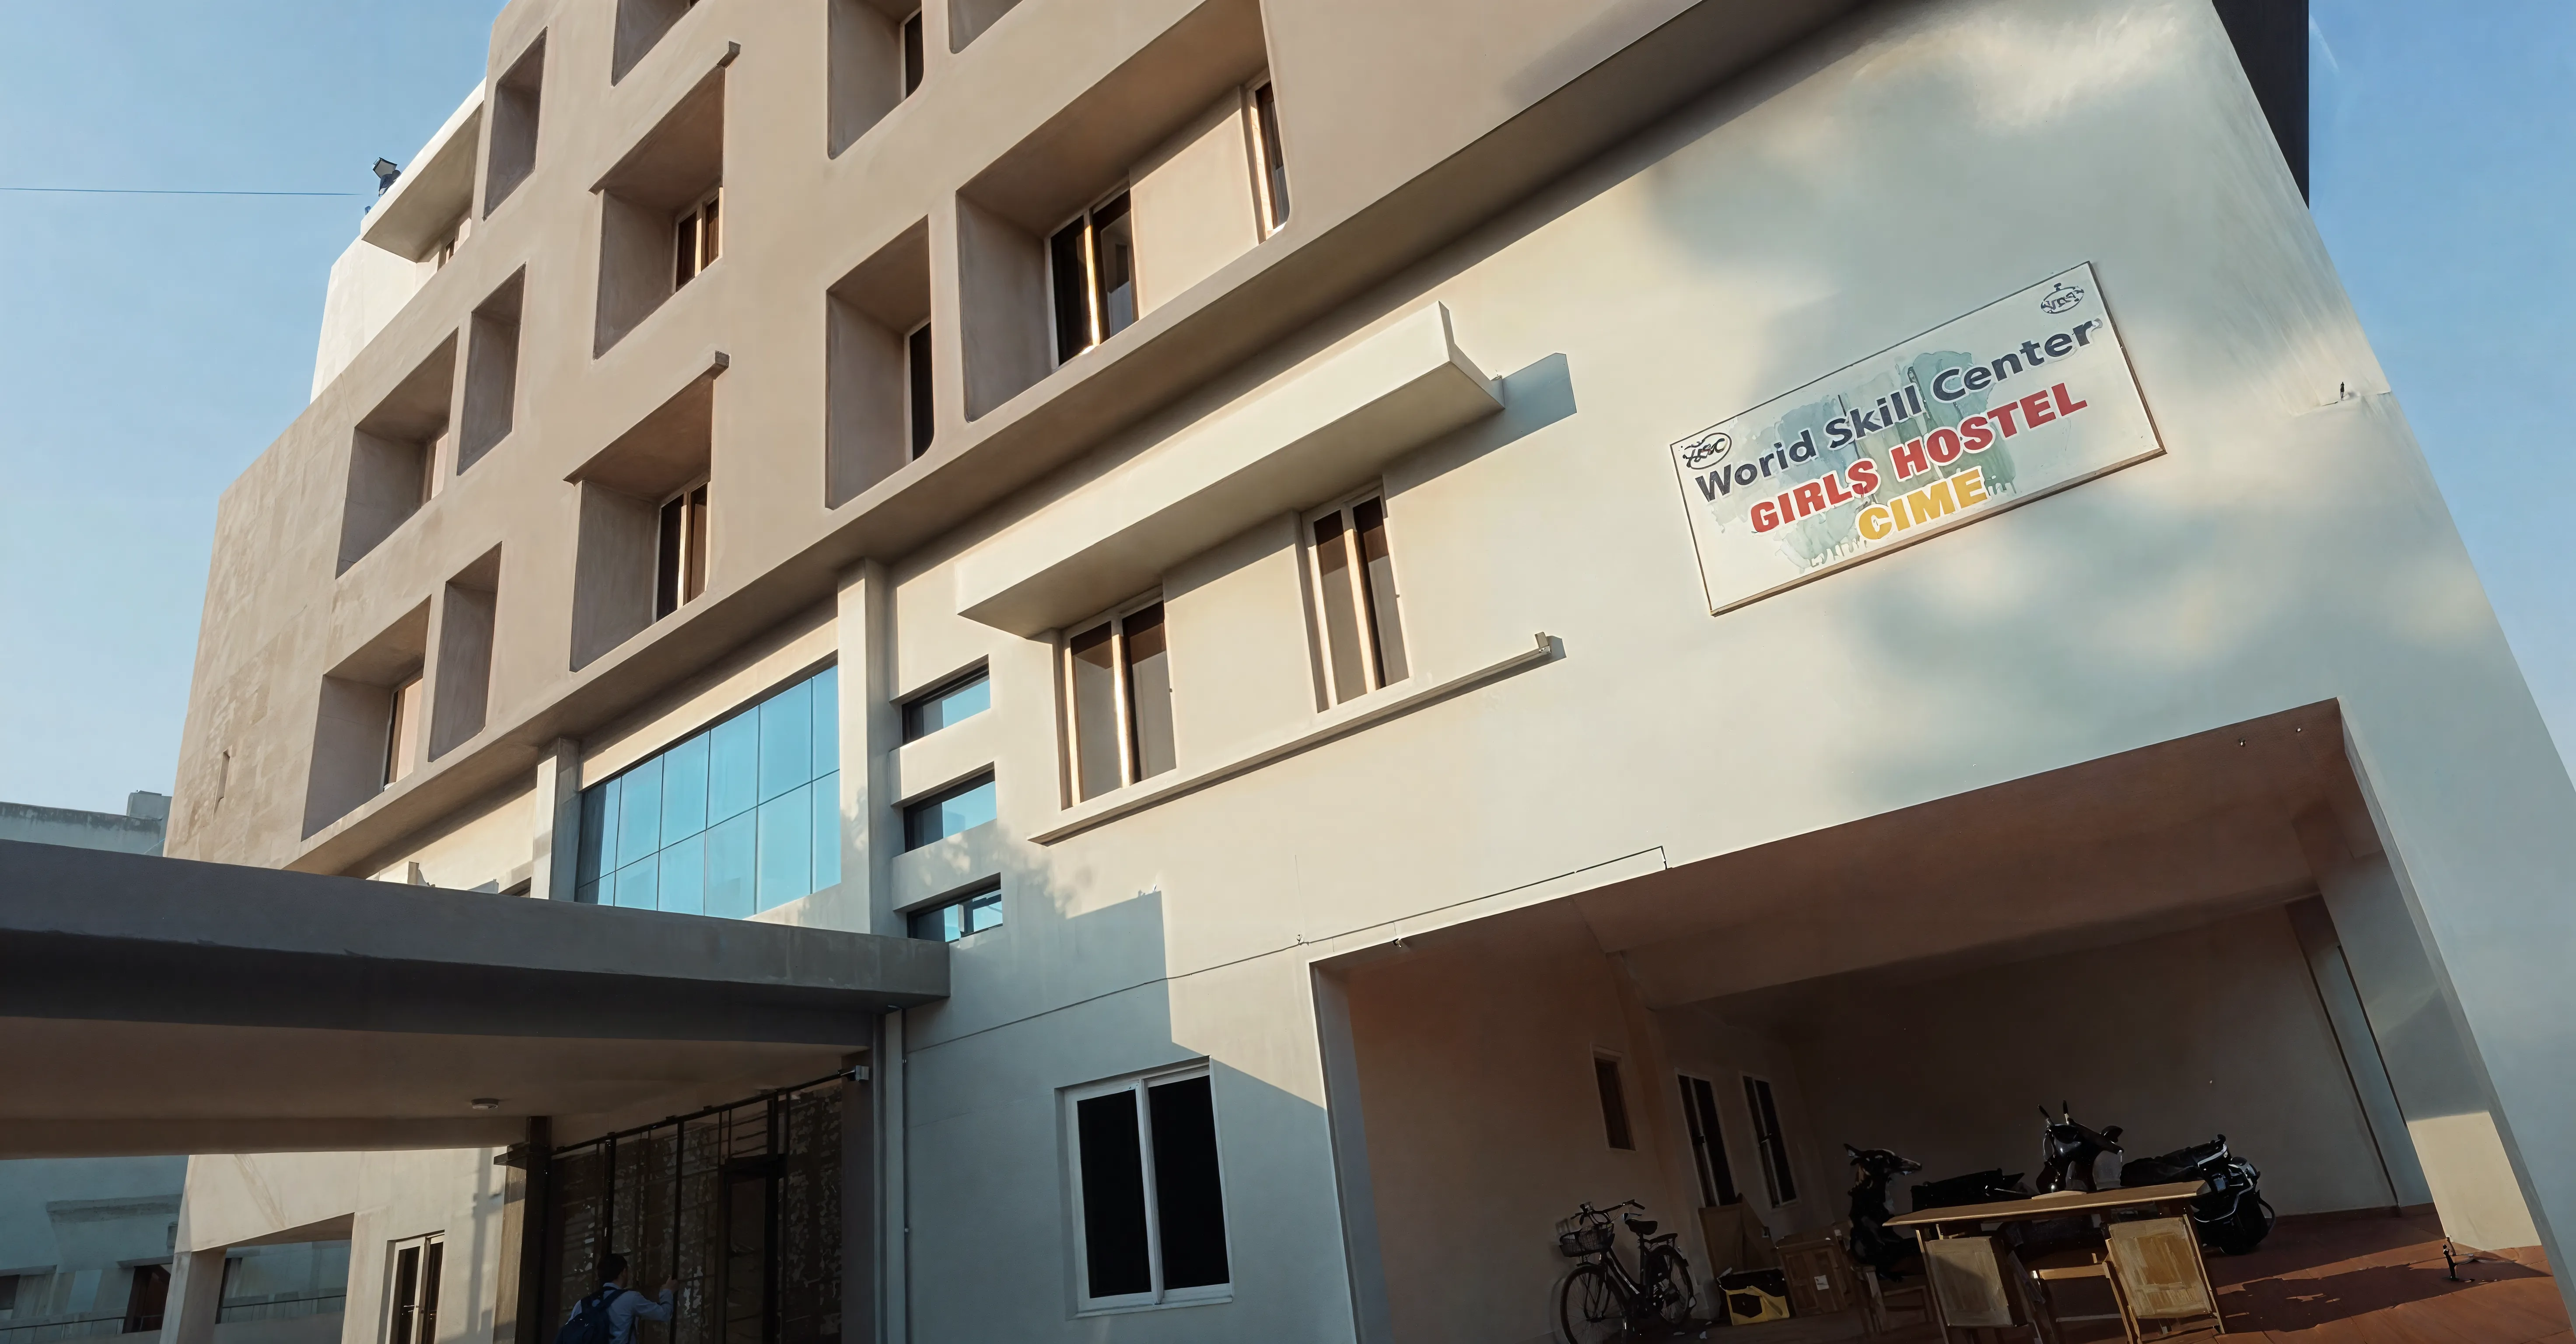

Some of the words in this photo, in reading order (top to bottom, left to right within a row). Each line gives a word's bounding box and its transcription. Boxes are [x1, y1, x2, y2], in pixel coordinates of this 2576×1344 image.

[1825, 385, 1922, 449] Skill
[1933, 320, 2090, 401] Center
[1750, 461, 1879, 532] GIRLS
[1890, 382, 2088, 479] HOSTEL
[1858, 469, 1988, 540] CIME
